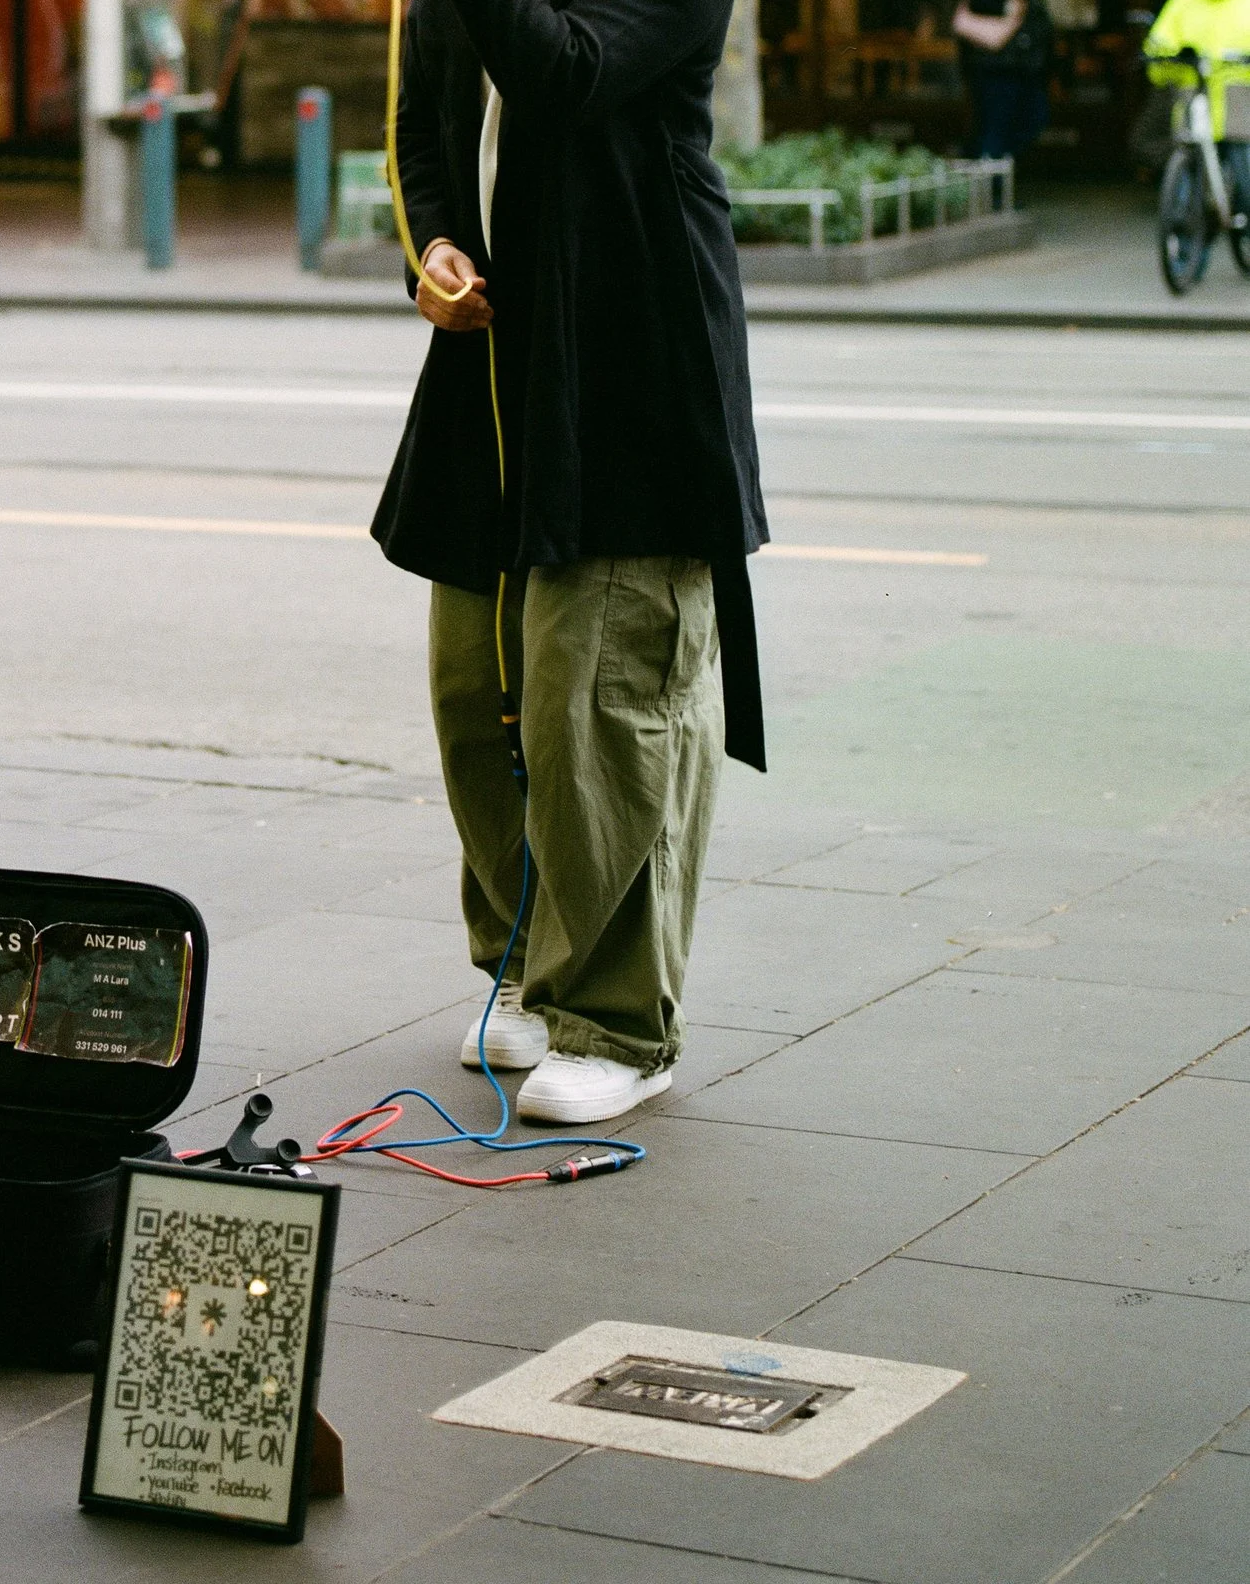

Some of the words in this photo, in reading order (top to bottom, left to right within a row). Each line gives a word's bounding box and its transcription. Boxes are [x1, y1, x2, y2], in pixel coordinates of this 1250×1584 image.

[84, 933, 115, 949] ANZ
[117, 936, 147, 951] Plus
[93, 974, 102, 983] M
[103, 974, 109, 983] A
[111, 975, 129, 985] Lara
[75, 1041, 91, 1050] 331
[123, 1416, 211, 1453] FOLLOW
[221, 1428, 253, 1463] ME
[258, 1432, 287, 1467] ON
[148, 1451, 223, 1480] Instagram
